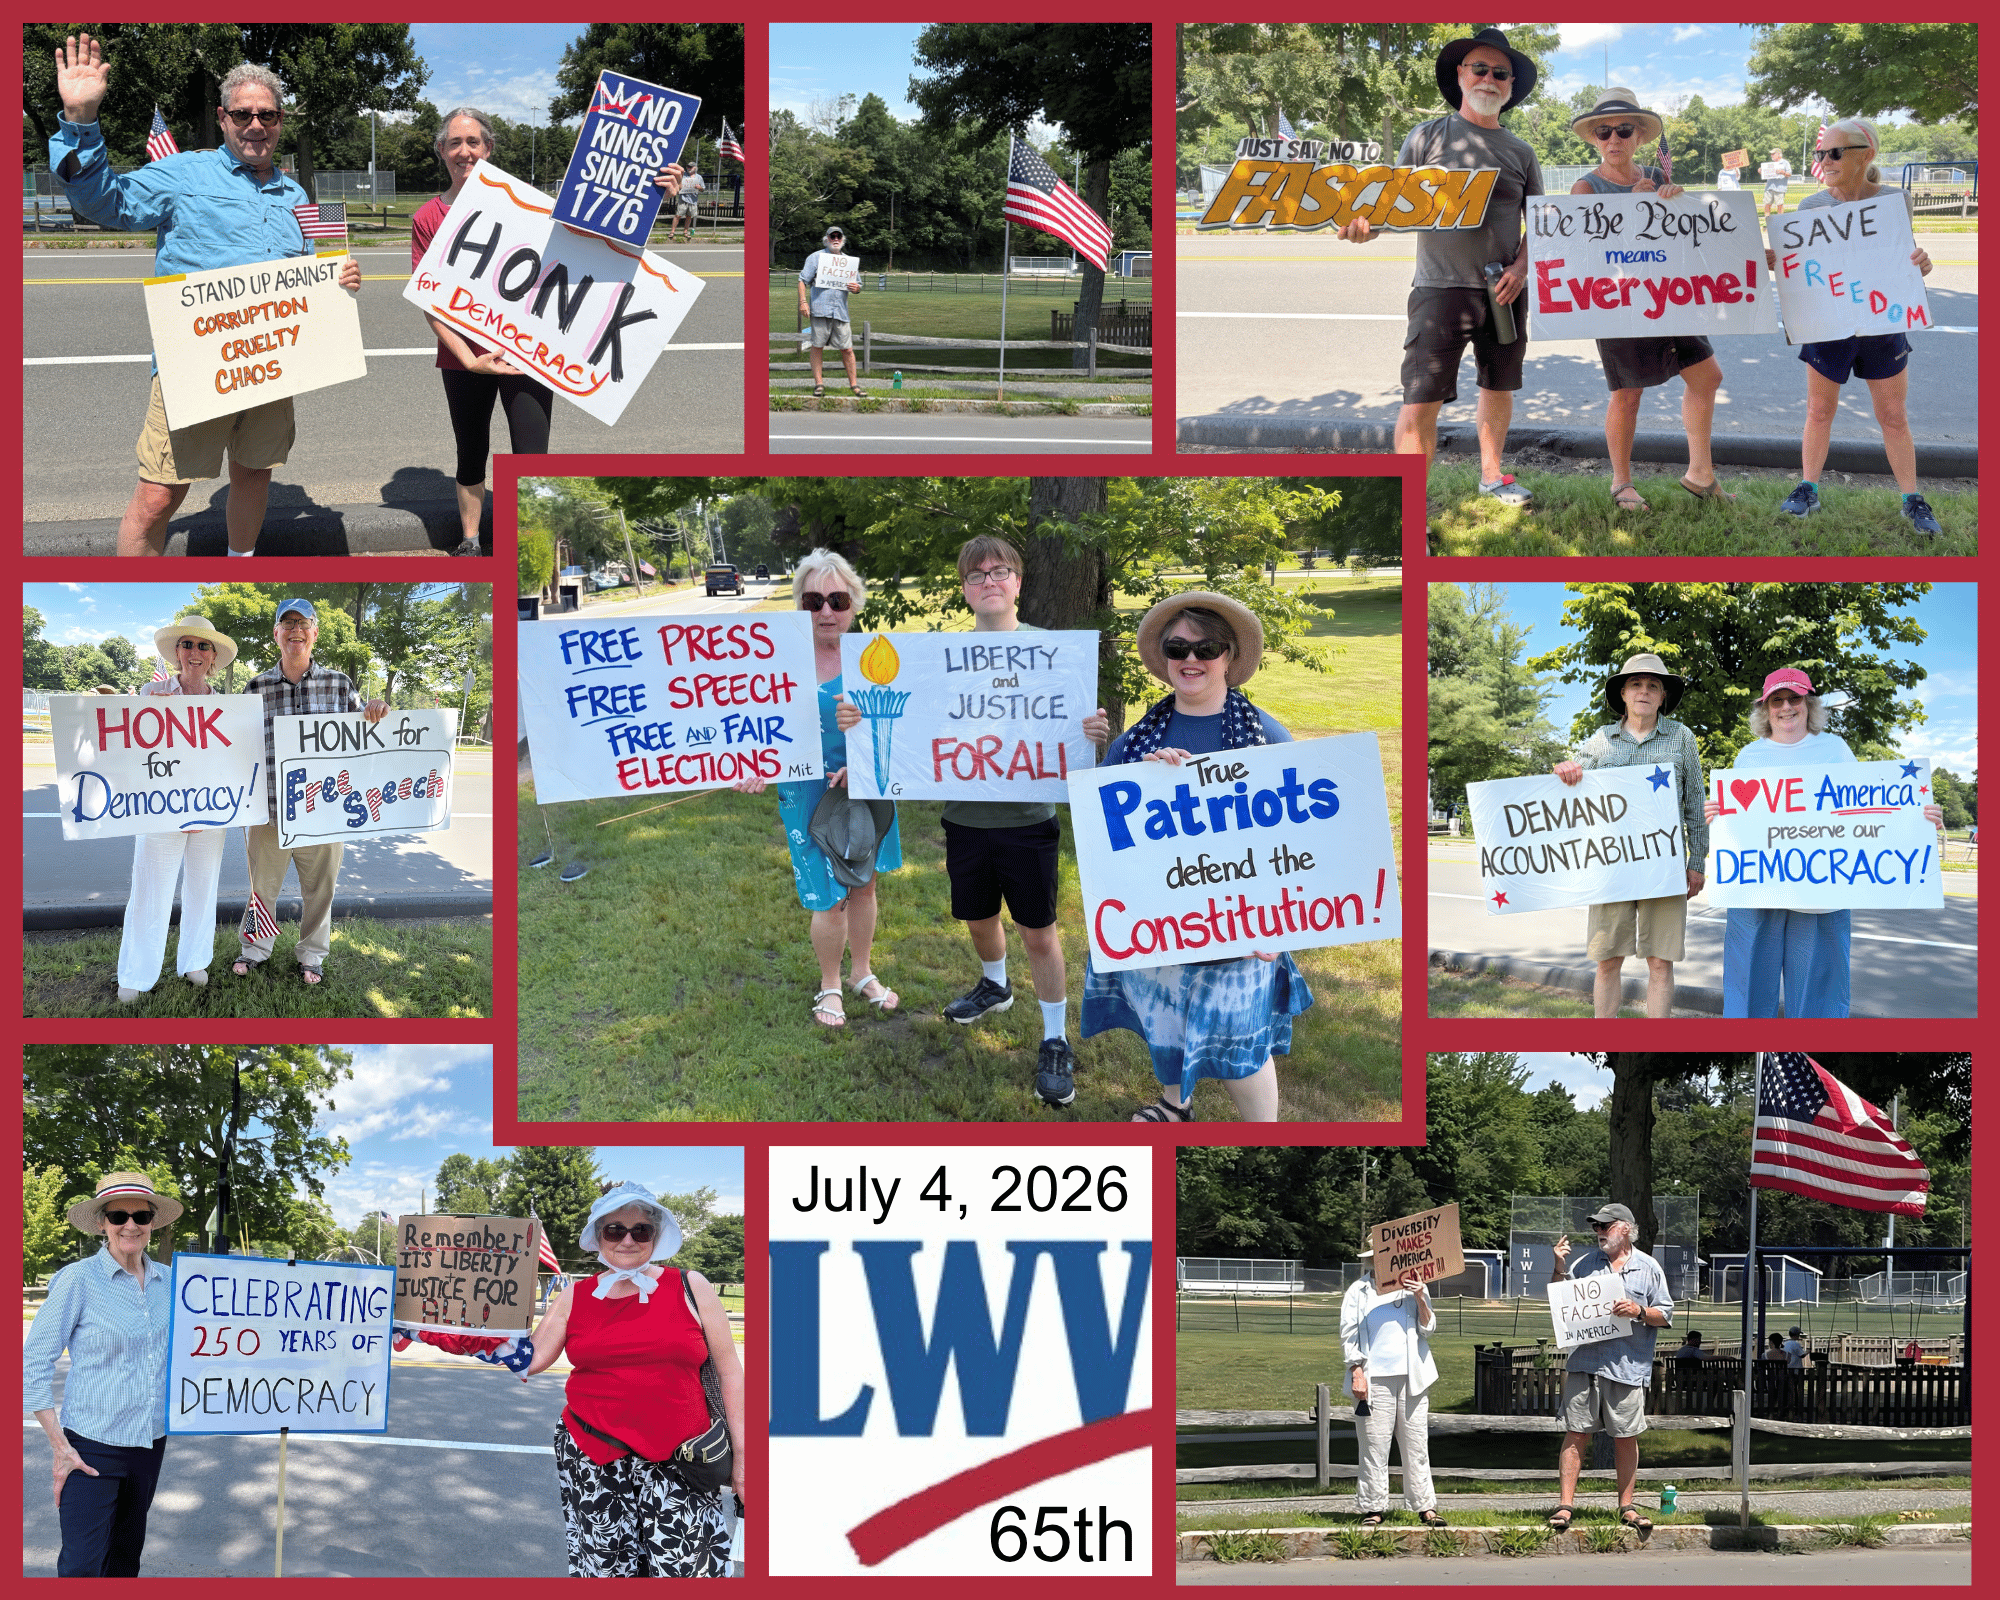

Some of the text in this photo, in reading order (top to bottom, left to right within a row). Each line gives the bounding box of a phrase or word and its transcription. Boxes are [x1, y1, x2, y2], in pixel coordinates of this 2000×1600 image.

[639, 94, 683, 137] NO
[590, 119, 669, 168] KINGS
[1239, 138, 1380, 161] JUST SAY NO TO
[580, 152, 657, 199] SINCE
[1201, 160, 1500, 227] FASCISM
[572, 182, 643, 235] 1776
[1530, 200, 1738, 248] We the People
[1783, 204, 1878, 249] SAVE
[822, 265, 858, 279] FACISM
[832, 256, 848, 267] NO
[1605, 249, 1667, 264] means
[180, 262, 338, 307] STAND UP AGAINST
[415, 271, 441, 293] for
[446, 210, 658, 383] HONK
[1534, 258, 1757, 320] Everyone!
[1782, 253, 1928, 330] FREEDOM
[193, 296, 309, 337] CORRUPTION
[449, 285, 610, 389] DEMOCRACY
[221, 324, 300, 362] CRUELTY
[215, 360, 282, 394] CHAOS
[559, 622, 775, 666] FREE PRESS
[945, 645, 1058, 673] LIBERTY
[565, 672, 798, 718] FREE SPEECH
[992, 673, 1019, 688] and
[948, 694, 1068, 720] JUSTICE
[96, 705, 233, 752] HONK
[299, 716, 430, 753] HONK for
[605, 713, 794, 757] FREE AND FAIR
[142, 751, 181, 779] for
[616, 748, 782, 791] ELECTIONS
[788, 763, 814, 778] Mit
[1186, 756, 1250, 787] True
[71, 762, 260, 829] Democracy!
[286, 767, 352, 821] Free
[1098, 767, 1340, 852] Patriots
[1503, 793, 1628, 838] DEMAND
[1768, 824, 1885, 849] preserve our
[1166, 844, 1316, 889] defend the
[1481, 825, 1678, 877] ACCOUNTABILITY
[1716, 845, 1932, 885] DEMOCRACY!
[1094, 868, 1386, 960] Constitution!
[399, 1250, 519, 1276] IT'S LIBERTY
[1396, 1231, 1433, 1253] MAKES
[181, 1274, 388, 1323] CELEBRATING
[396, 1276, 518, 1306] JUSTICE FOR
[1561, 1300, 1616, 1322] FACIS
[1573, 1280, 1601, 1301] NO
[190, 1326, 384, 1357] 250 YEARS OF
[1565, 1323, 1620, 1341] IN AMERICA
[180, 1377, 376, 1415] DEMOCRACY
